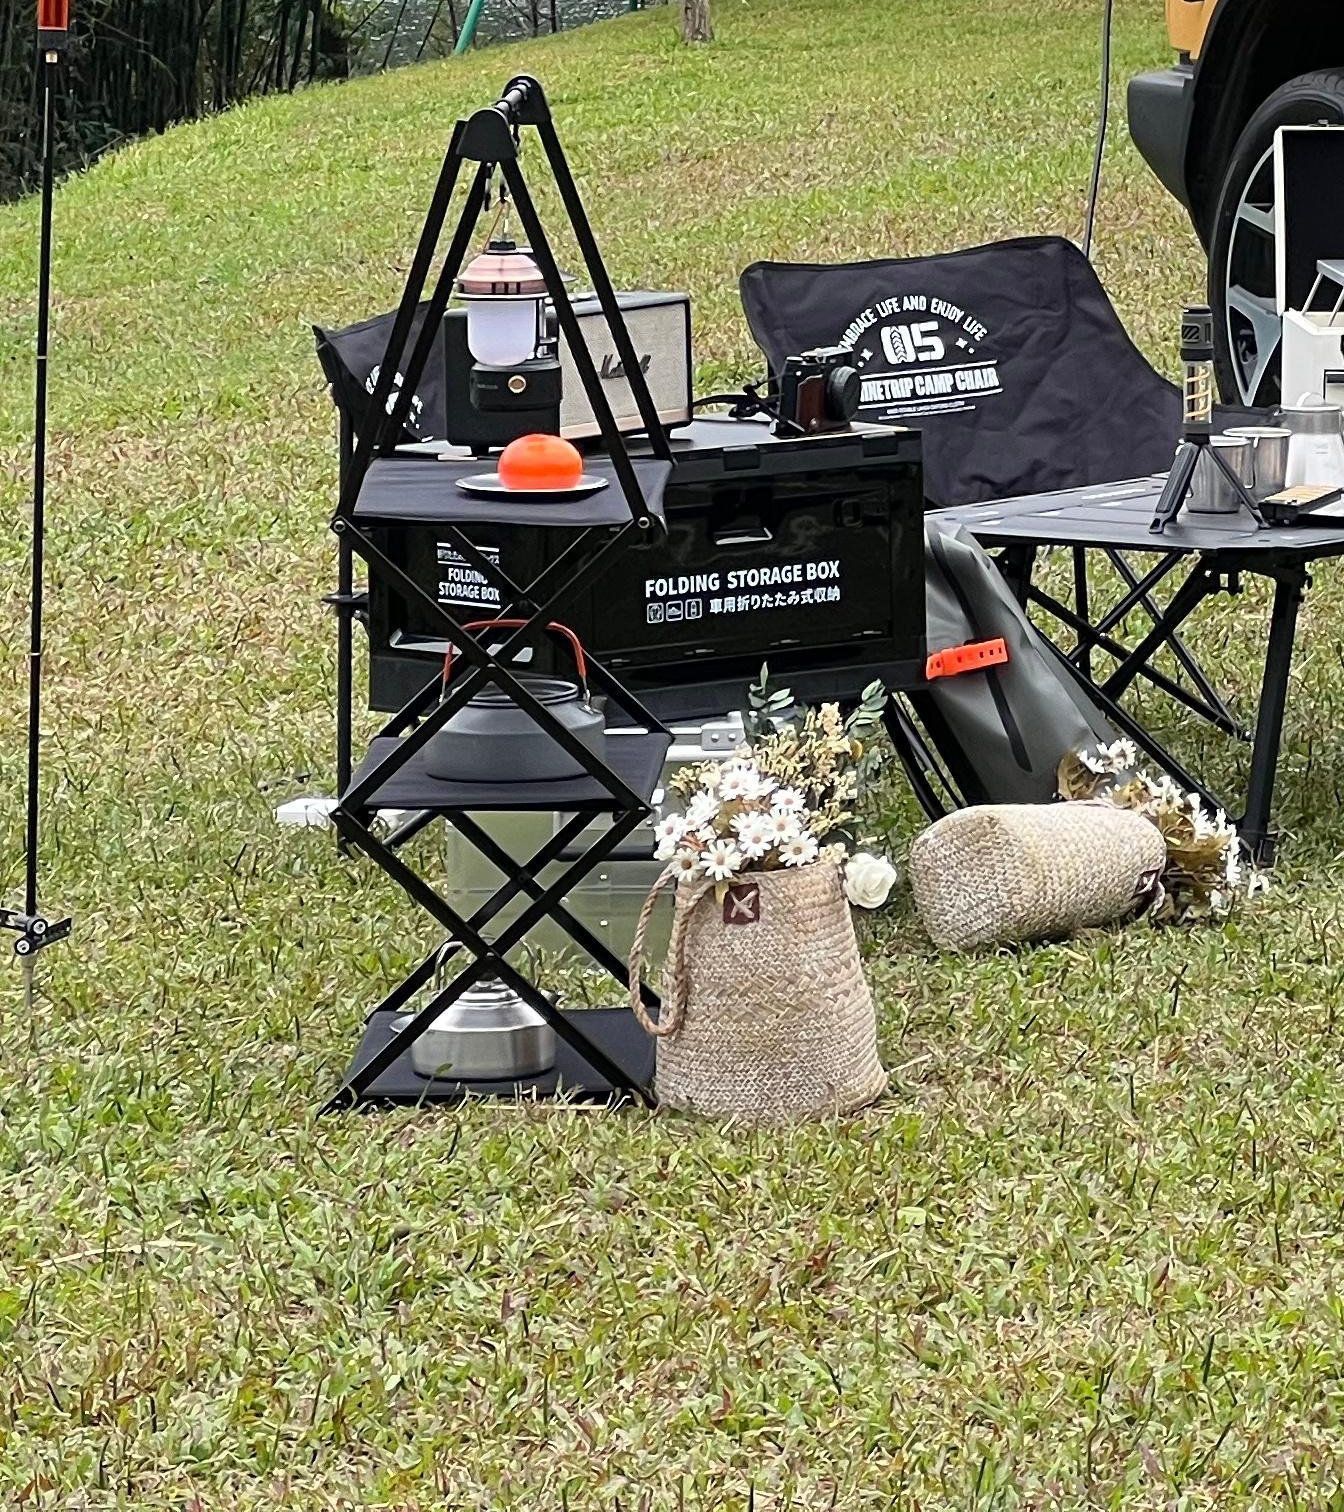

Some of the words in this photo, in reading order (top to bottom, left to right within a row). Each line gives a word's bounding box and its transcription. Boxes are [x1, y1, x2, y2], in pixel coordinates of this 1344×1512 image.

[838, 308, 878, 351] MBRACE
[875, 296, 901, 318] LIFE
[902, 295, 927, 311] AND
[930, 297, 965, 324] ENJOY
[962, 316, 988, 342] LIFE
[880, 320, 946, 365] 05
[914, 372, 955, 397] CAMP
[954, 367, 1000, 391] CHAIR
[438, 581, 480, 600] STORAGE
[480, 586, 500, 602] BOX
[645, 572, 720, 598] FOLDING
[727, 564, 803, 589] STORAGE
[806, 559, 841, 581] BOX
